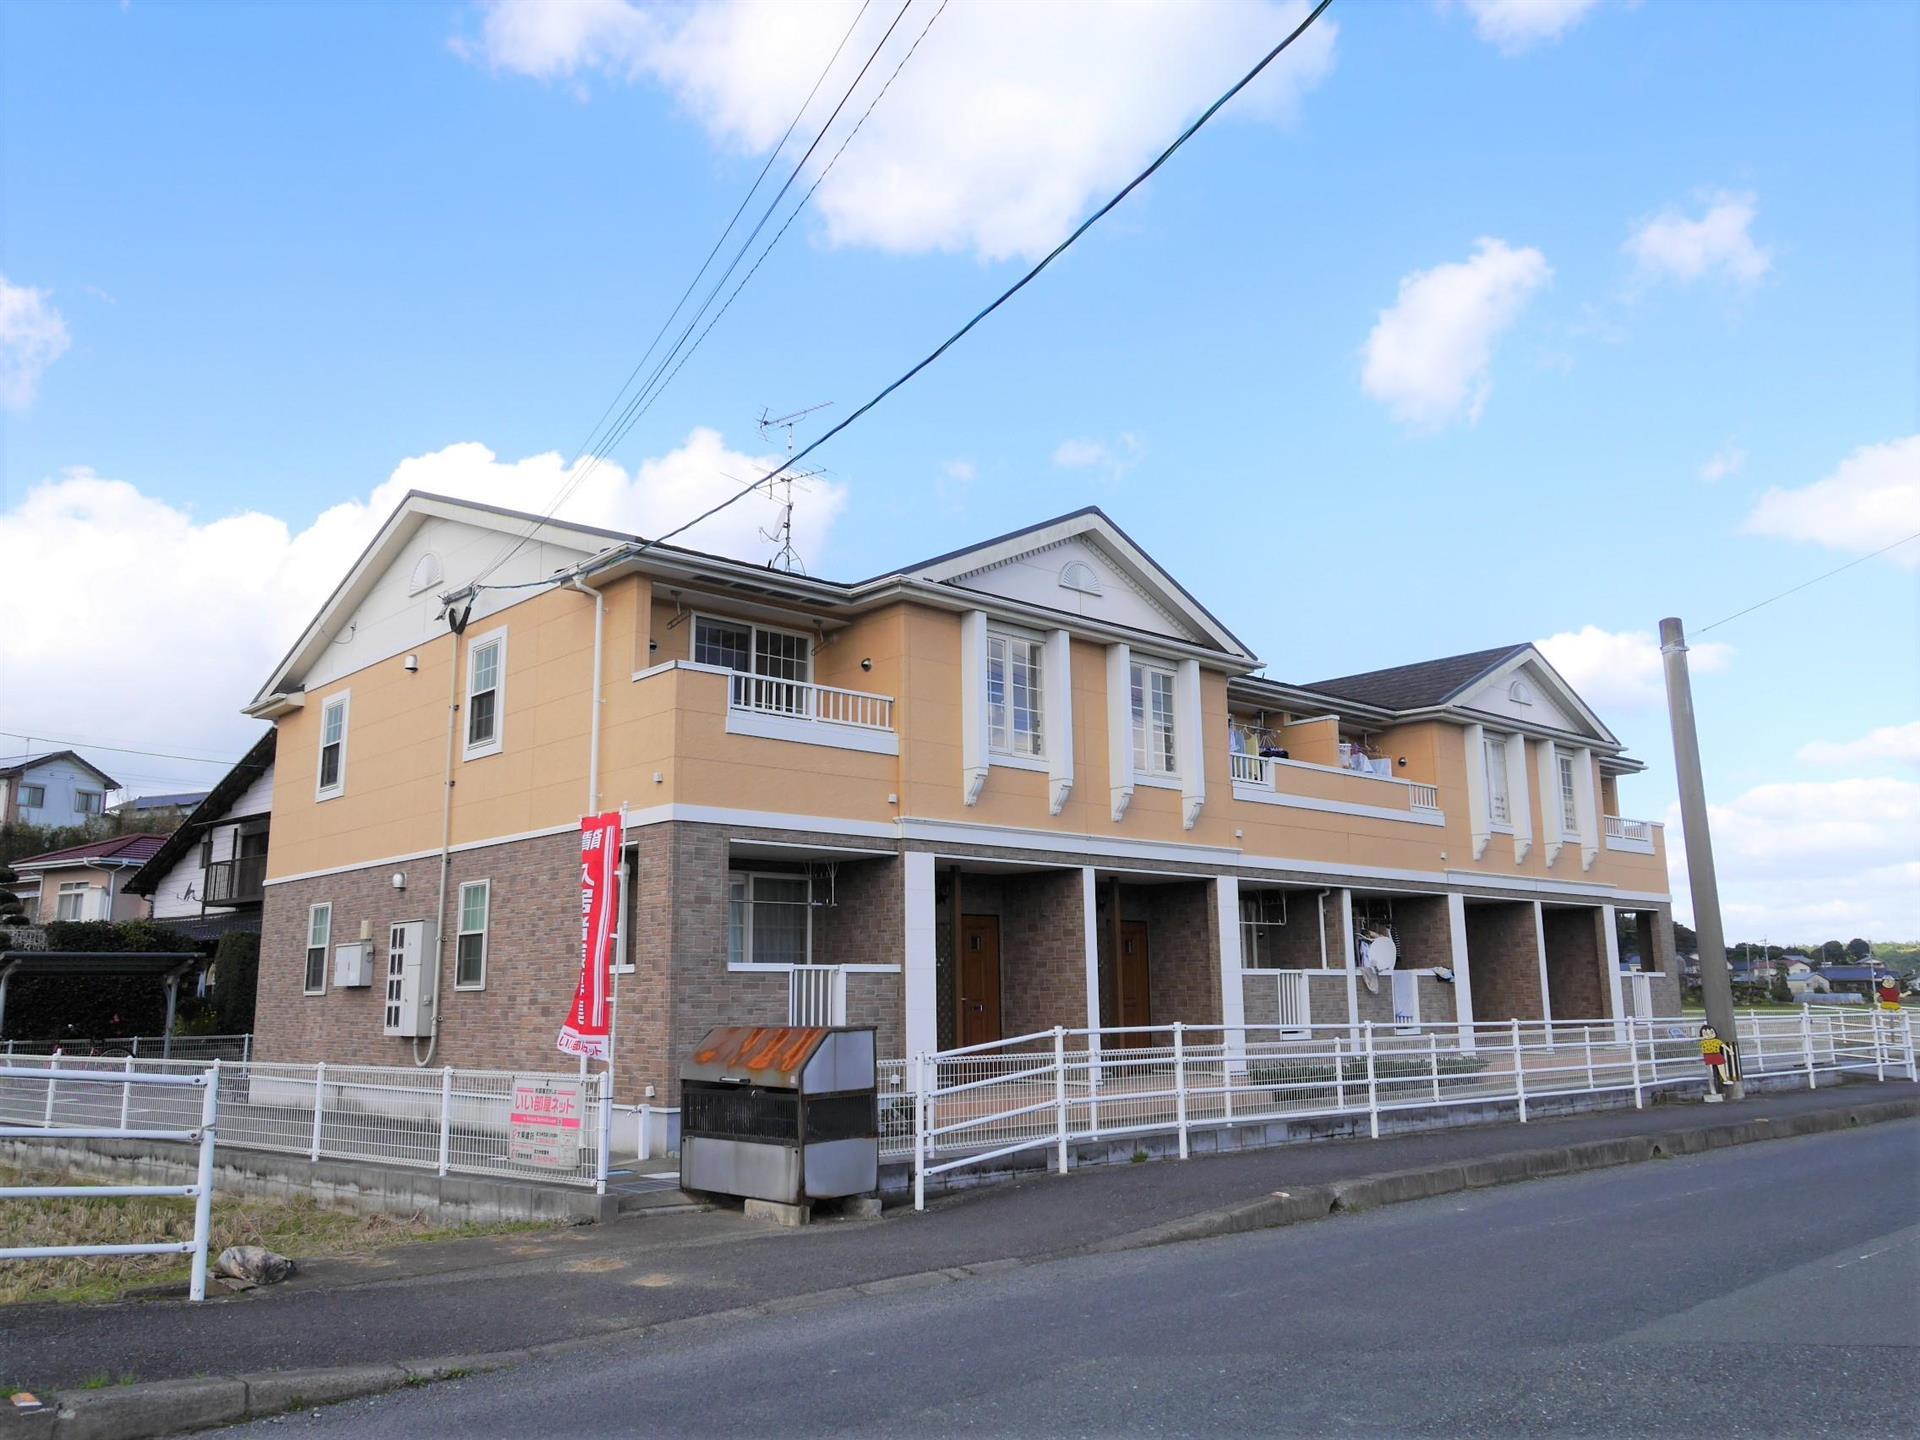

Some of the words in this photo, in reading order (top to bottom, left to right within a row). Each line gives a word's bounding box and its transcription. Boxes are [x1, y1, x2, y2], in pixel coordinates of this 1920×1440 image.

[515, 1094, 575, 1114] いい部屋ネット
